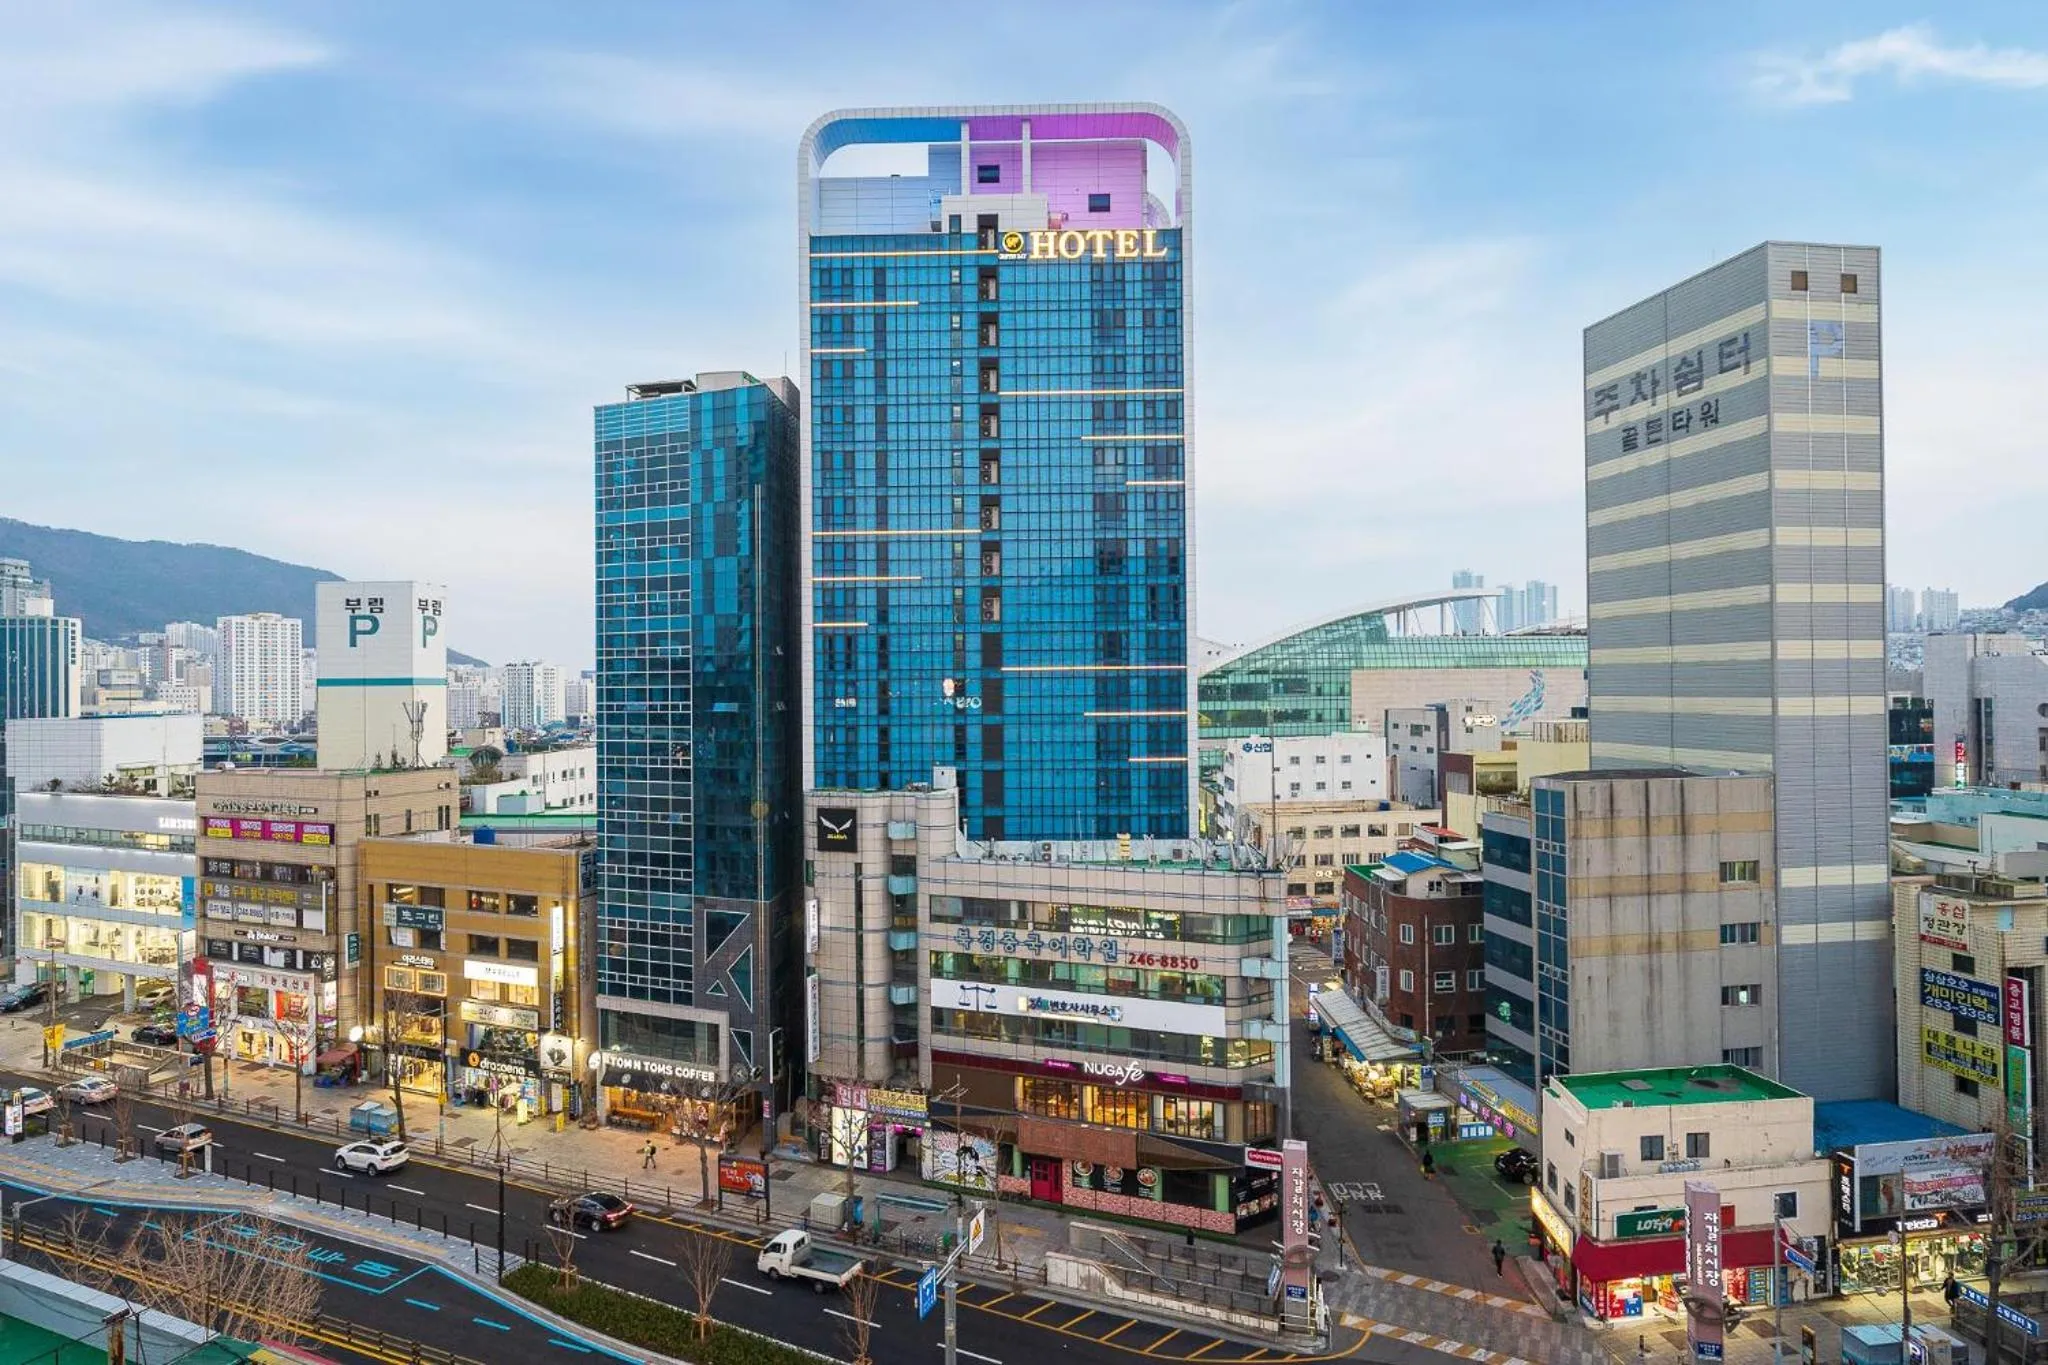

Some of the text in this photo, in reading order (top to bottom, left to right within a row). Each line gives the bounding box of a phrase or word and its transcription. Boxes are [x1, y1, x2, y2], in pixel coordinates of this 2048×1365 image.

[1029, 229, 1168, 259] HOTEL
[345, 597, 384, 614] 부림
[417, 598, 442, 616] 부림
[349, 614, 380, 648] P
[422, 615, 438, 648] P
[158, 817, 196, 830] SAMSUN
[1936, 902, 1966, 919] 홍삼
[1923, 916, 1967, 935] 정관장
[954, 927, 1118, 963] 북경중국어학원
[1128, 953, 1199, 970] 246-8850
[1924, 983, 1988, 1013] 개미인력
[643, 1062, 673, 1076] TOMS
[675, 1066, 715, 1082] COFFEE
[1292, 1167, 1304, 1235] 자갈치시장
[1703, 1212, 1719, 1287] 자갈치시장
